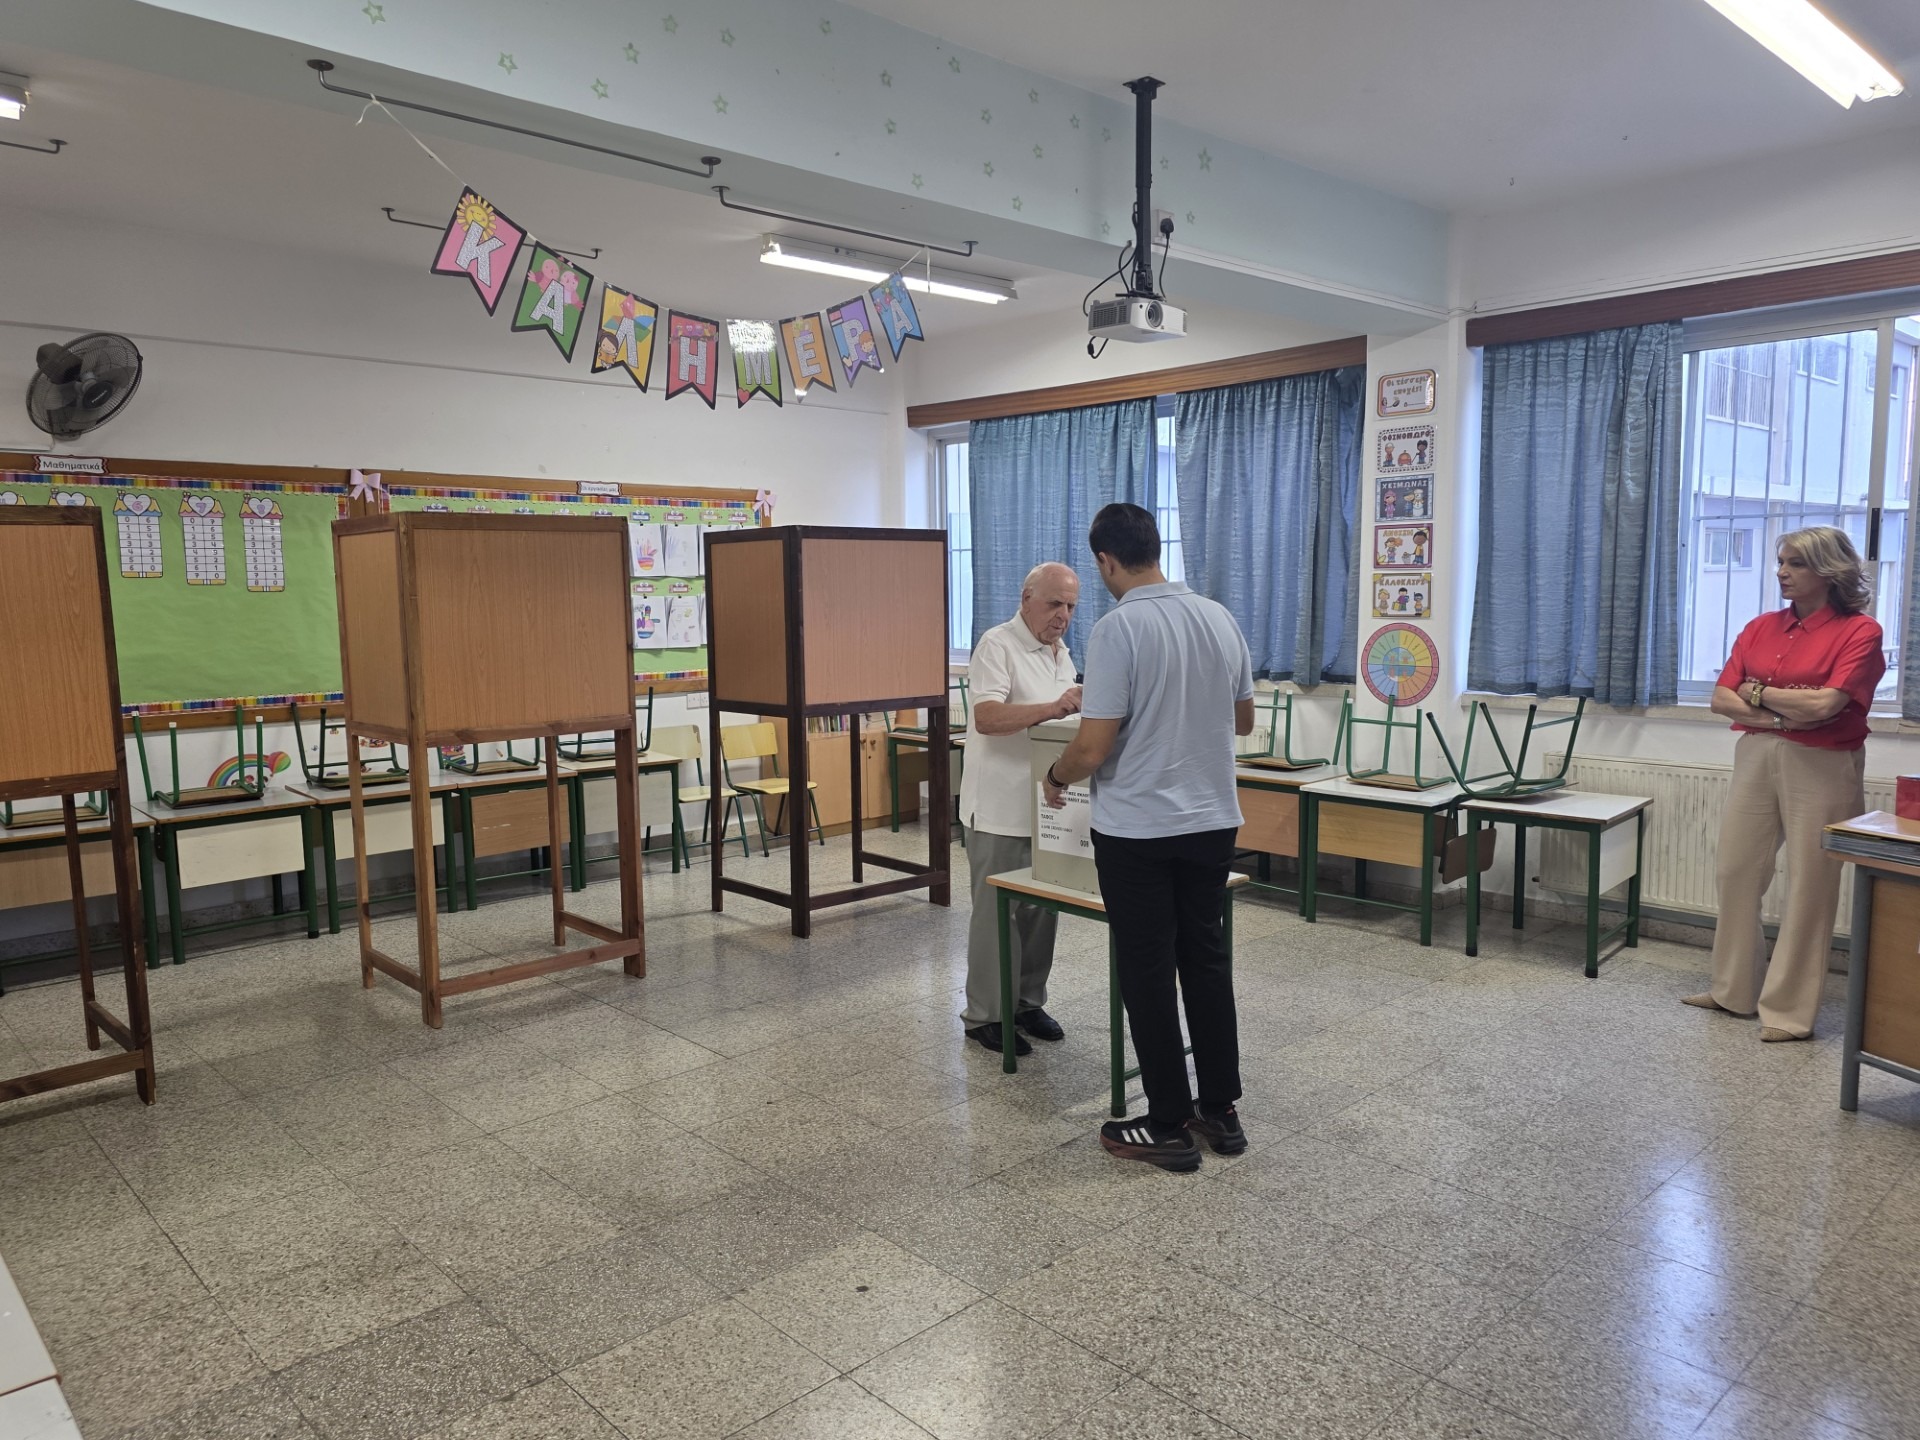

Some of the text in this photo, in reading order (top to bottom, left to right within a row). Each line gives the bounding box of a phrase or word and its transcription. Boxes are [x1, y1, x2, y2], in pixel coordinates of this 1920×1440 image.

[43, 460, 100, 471] Μαθηματικά
[196, 503, 206, 513] 7
[257, 504, 265, 514] 8
